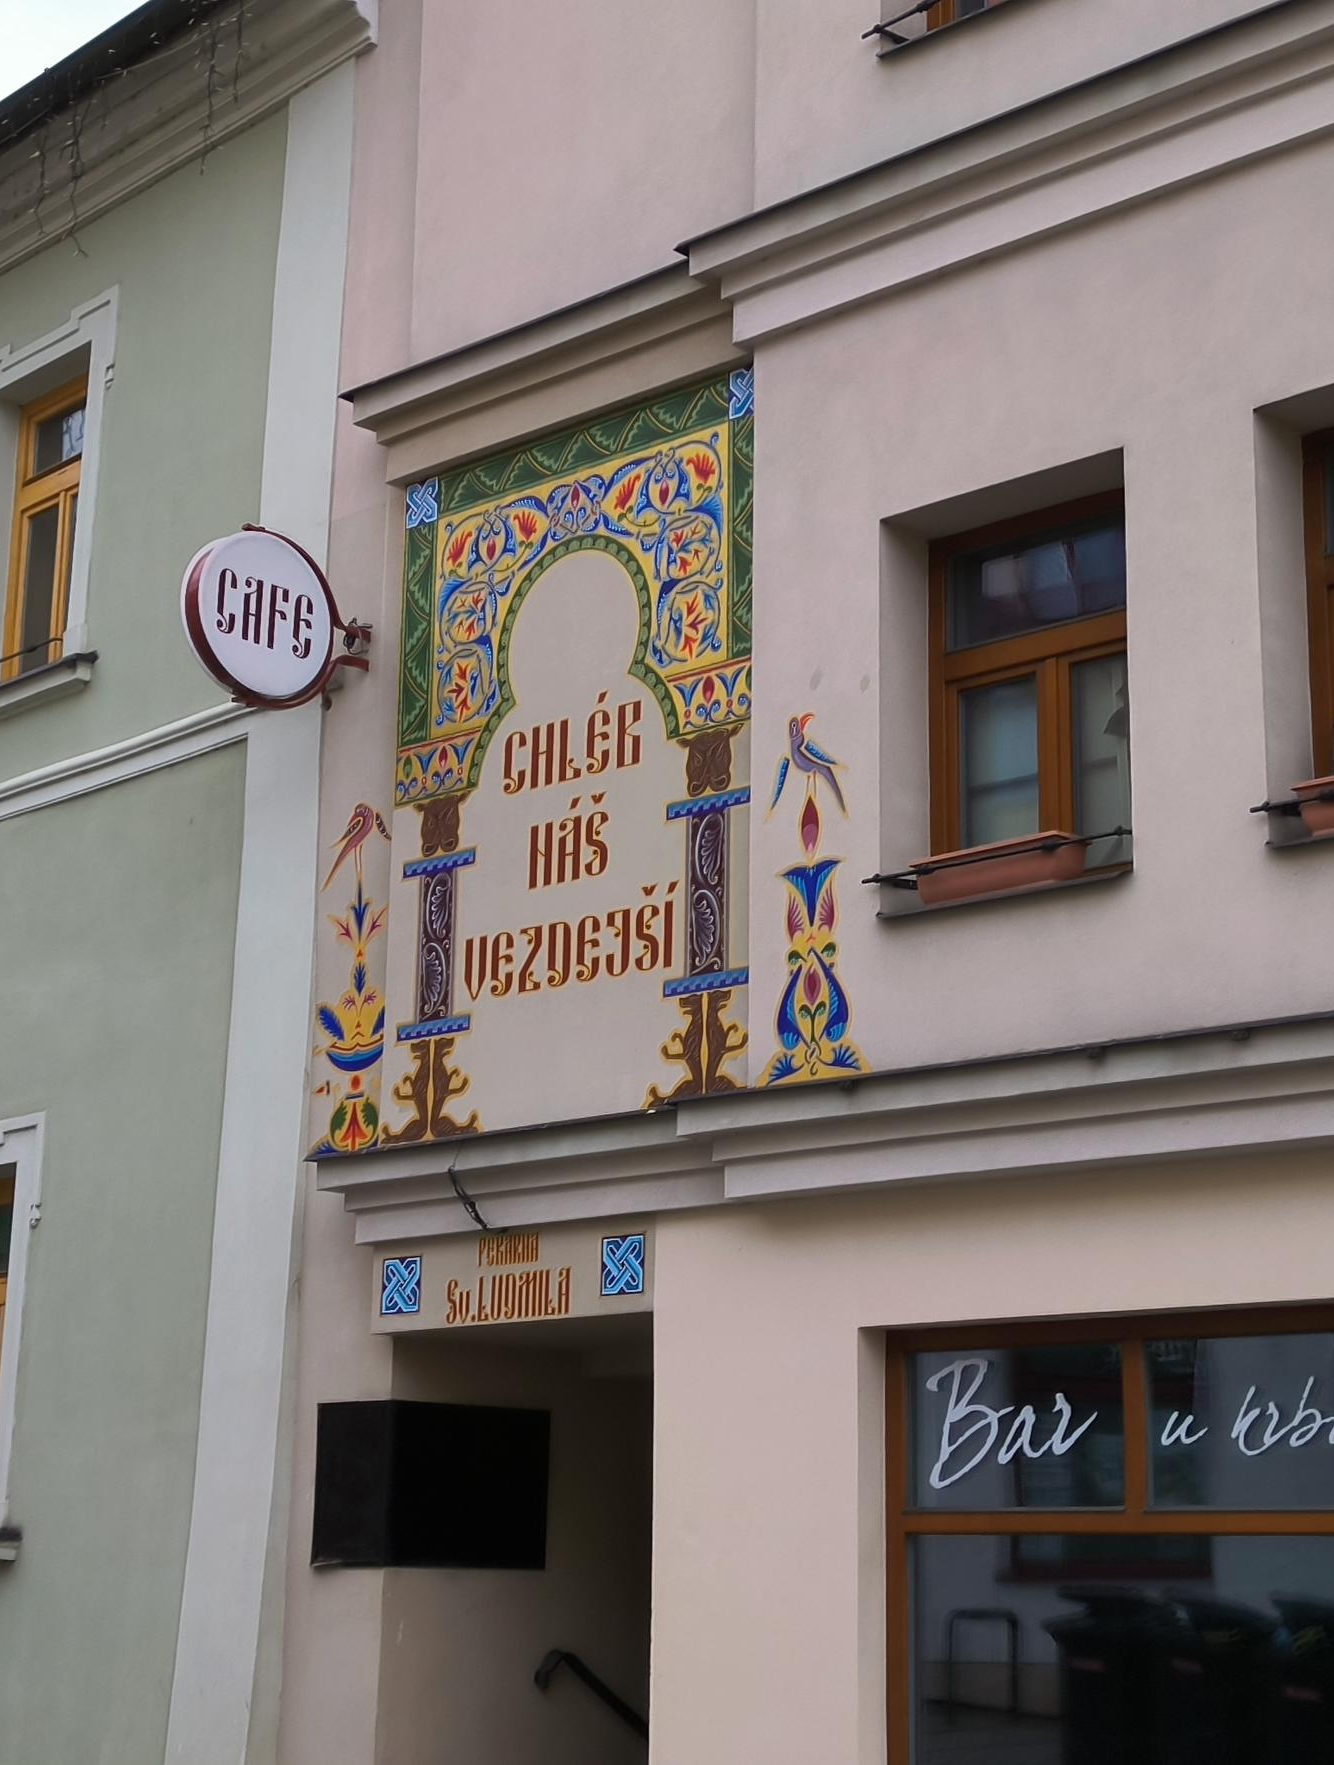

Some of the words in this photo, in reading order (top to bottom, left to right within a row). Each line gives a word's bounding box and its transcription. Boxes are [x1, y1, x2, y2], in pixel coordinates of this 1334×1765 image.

[216, 567, 314, 660] CAFE
[503, 689, 643, 796] CHLÉB
[528, 790, 610, 891] NÁŠ
[463, 878, 681, 1002] VEZDEJŠÍ
[926, 1358, 1099, 1490] Bar
[1160, 1410, 1209, 1447] u
